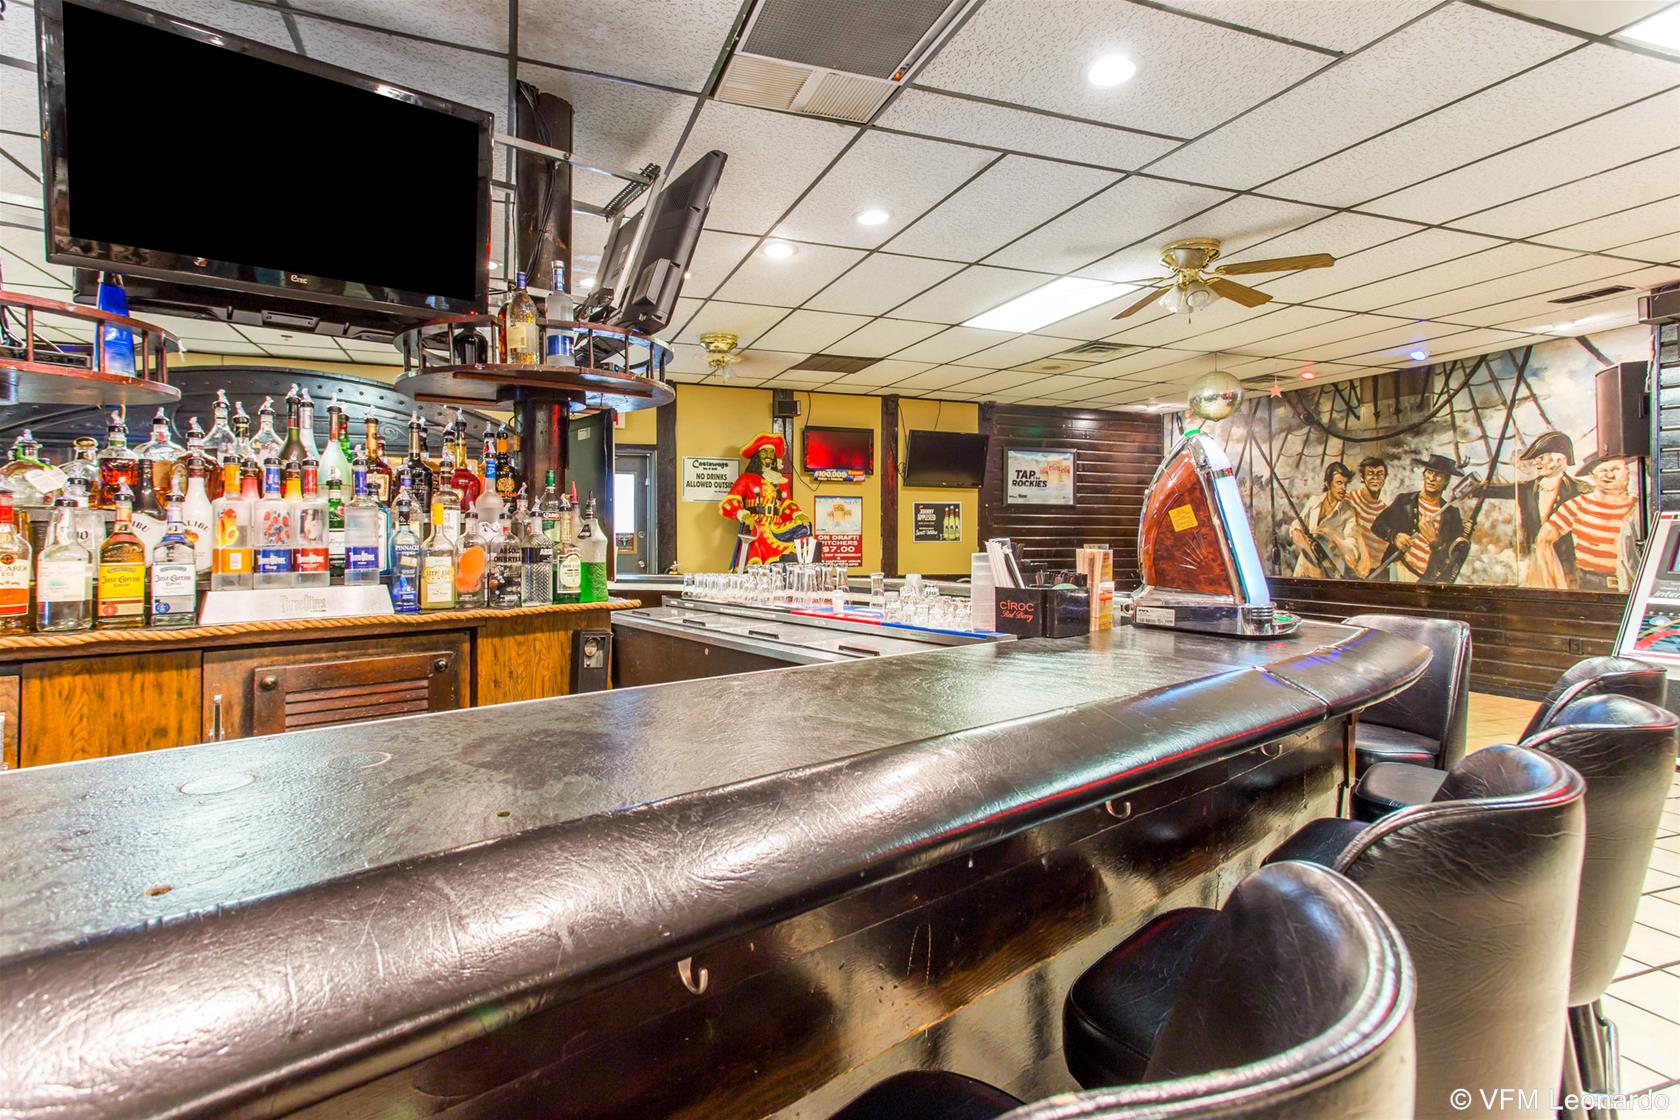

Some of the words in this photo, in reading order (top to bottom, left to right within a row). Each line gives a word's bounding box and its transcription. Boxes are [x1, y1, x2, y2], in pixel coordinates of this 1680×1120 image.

[707, 473, 727, 481] DRINKS
[1015, 469, 1036, 480] TAP
[713, 481, 734, 489] OUTSID
[1012, 479, 1048, 488] ROCKIES
[823, 545, 855, 553] $7.00
